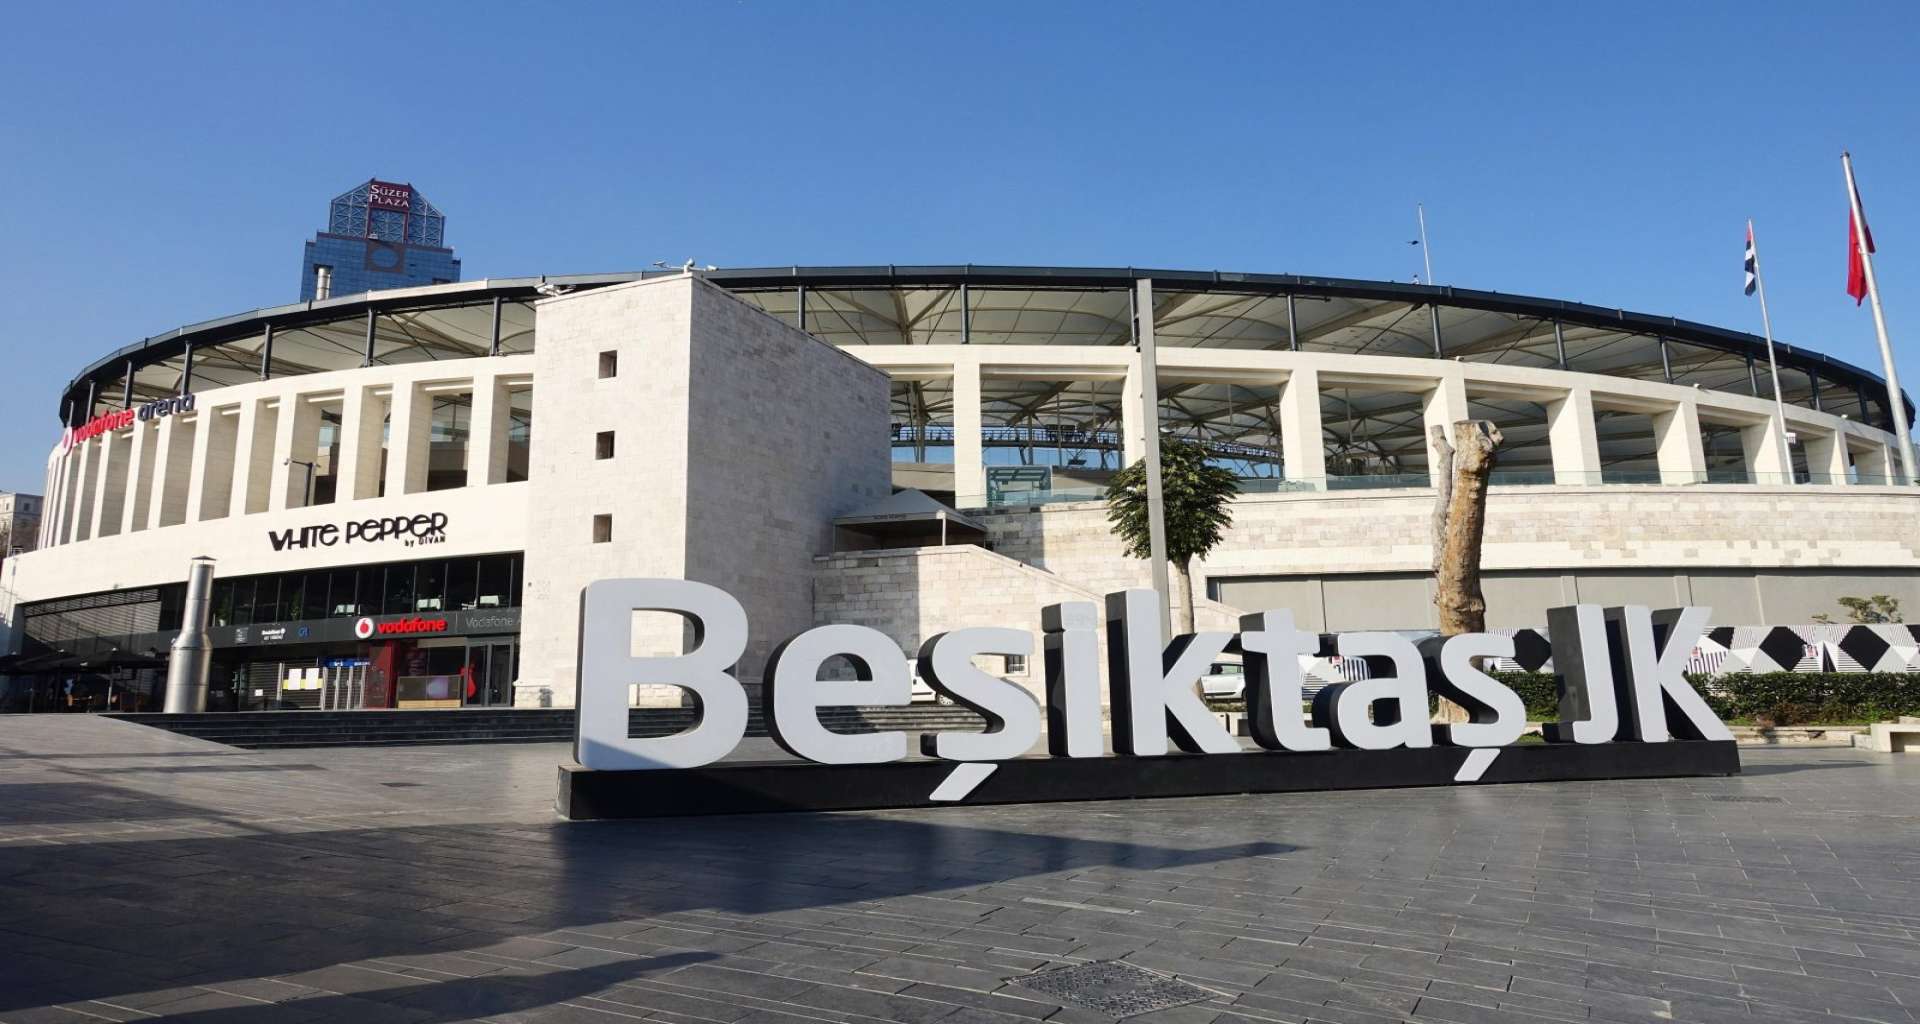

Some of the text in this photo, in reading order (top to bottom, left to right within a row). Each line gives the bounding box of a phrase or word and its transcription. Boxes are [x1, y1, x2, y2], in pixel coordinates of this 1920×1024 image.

[369, 193, 409, 207] PLAZA
[73, 394, 194, 443] vodafone arena
[378, 618, 446, 634] vodafone
